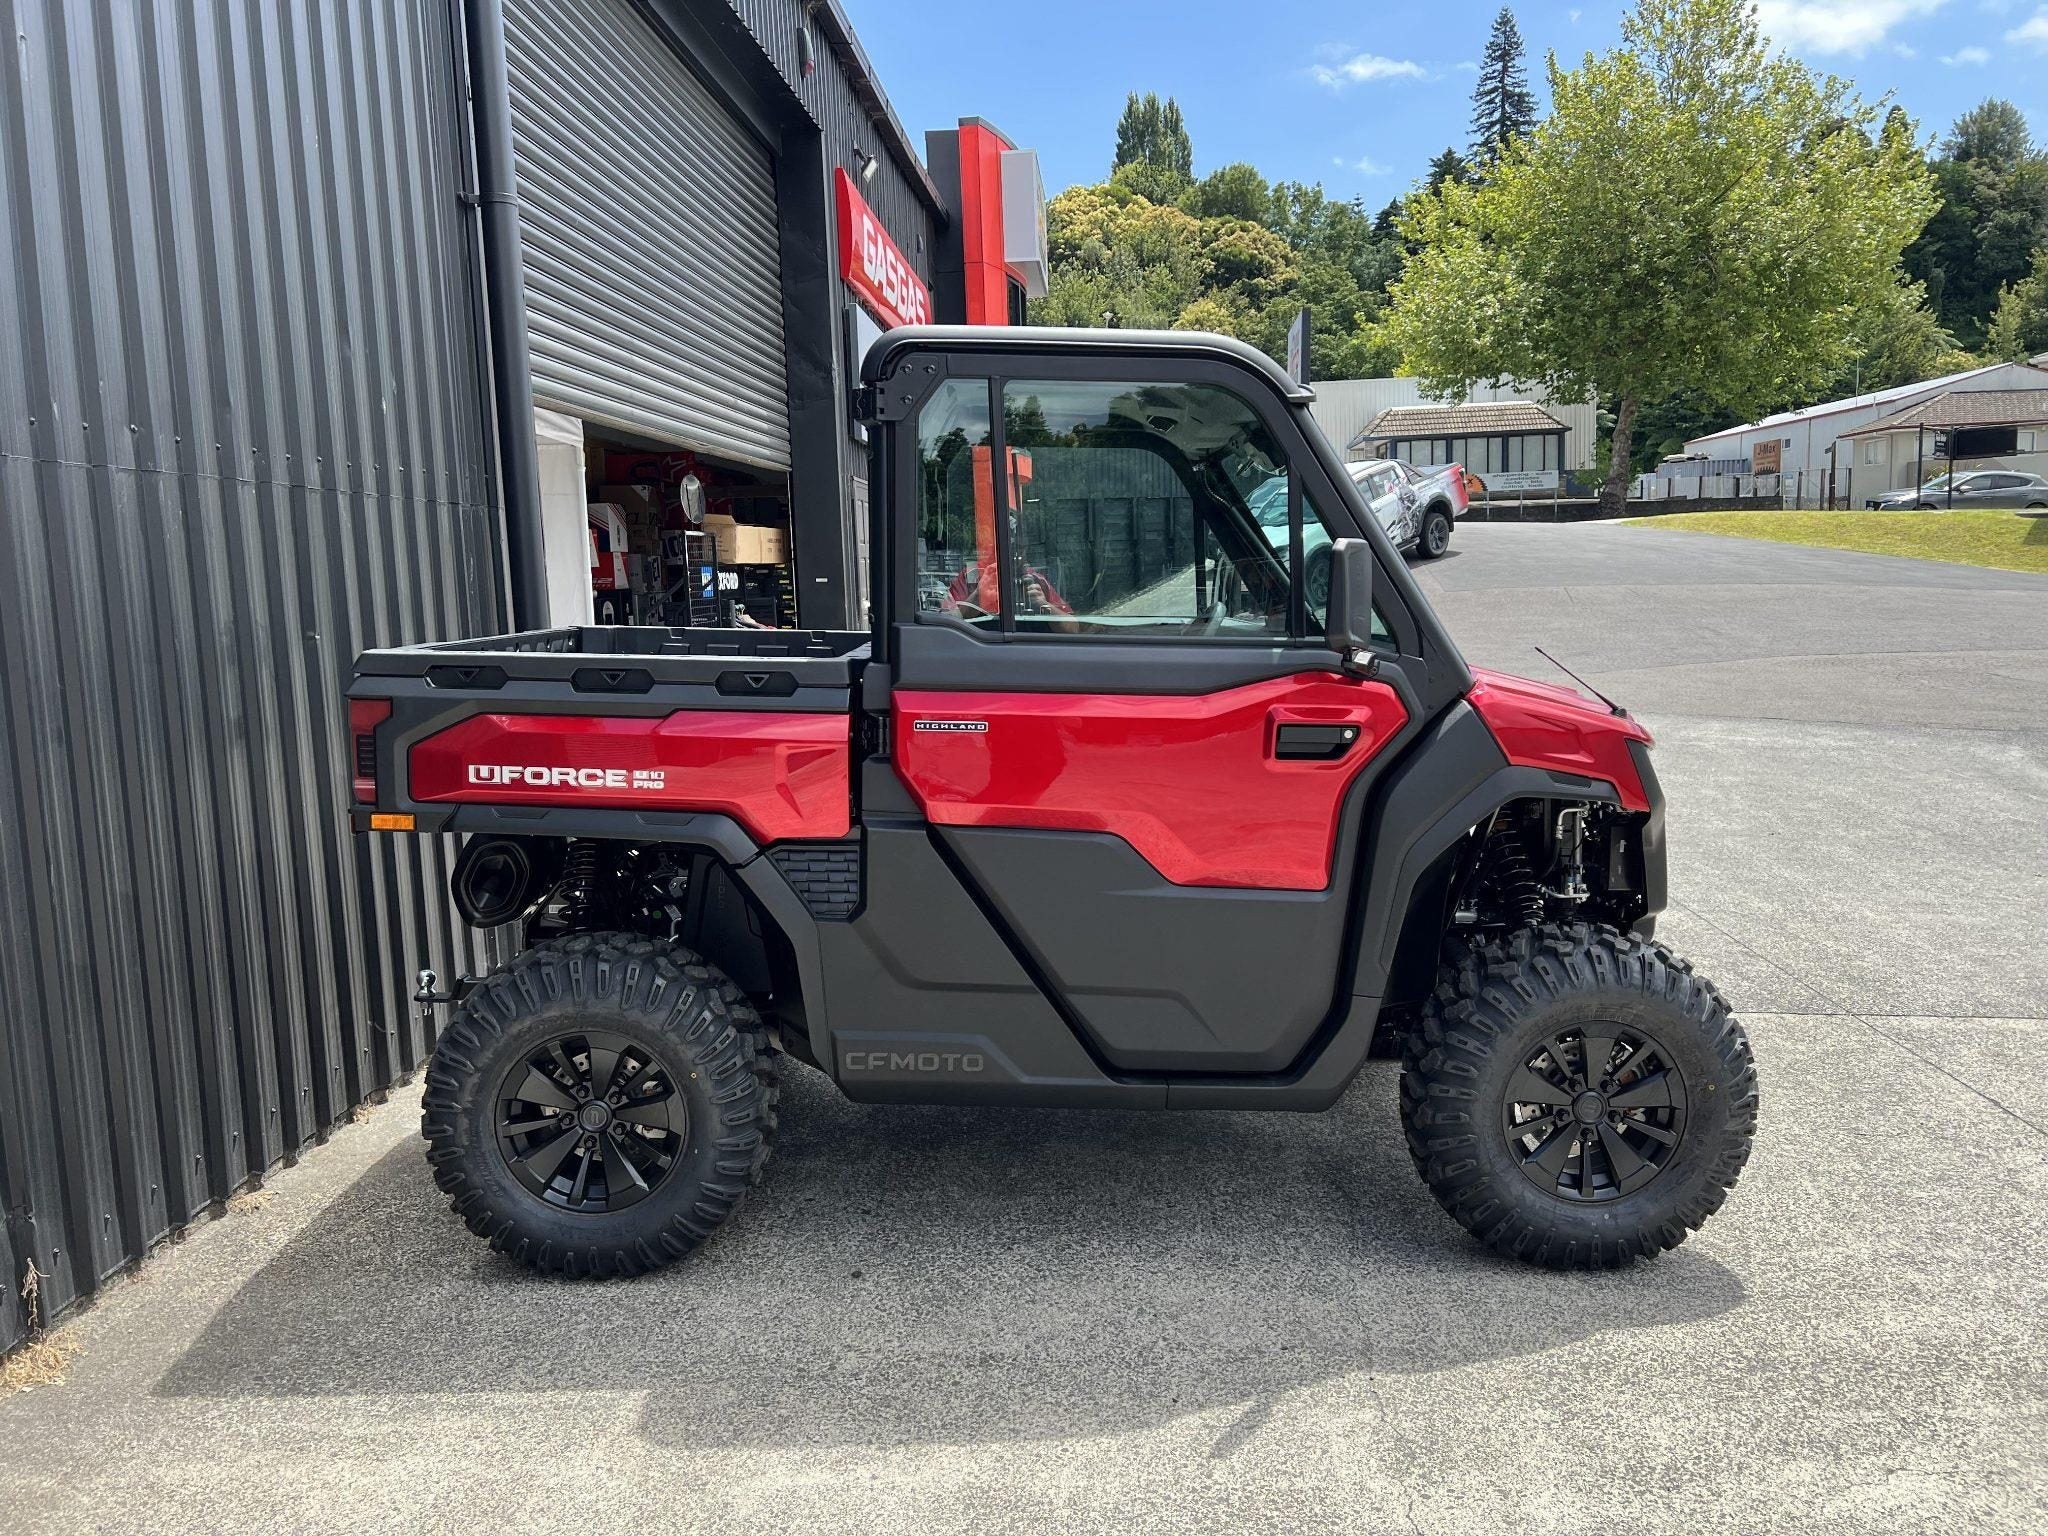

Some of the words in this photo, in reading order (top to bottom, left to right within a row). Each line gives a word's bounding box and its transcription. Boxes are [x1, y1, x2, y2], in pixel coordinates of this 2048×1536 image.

[862, 213, 926, 325] GASGAS
[468, 764, 629, 788] UFORCE
[633, 780, 665, 790] PRO
[845, 1052, 984, 1072] CFMOTO
